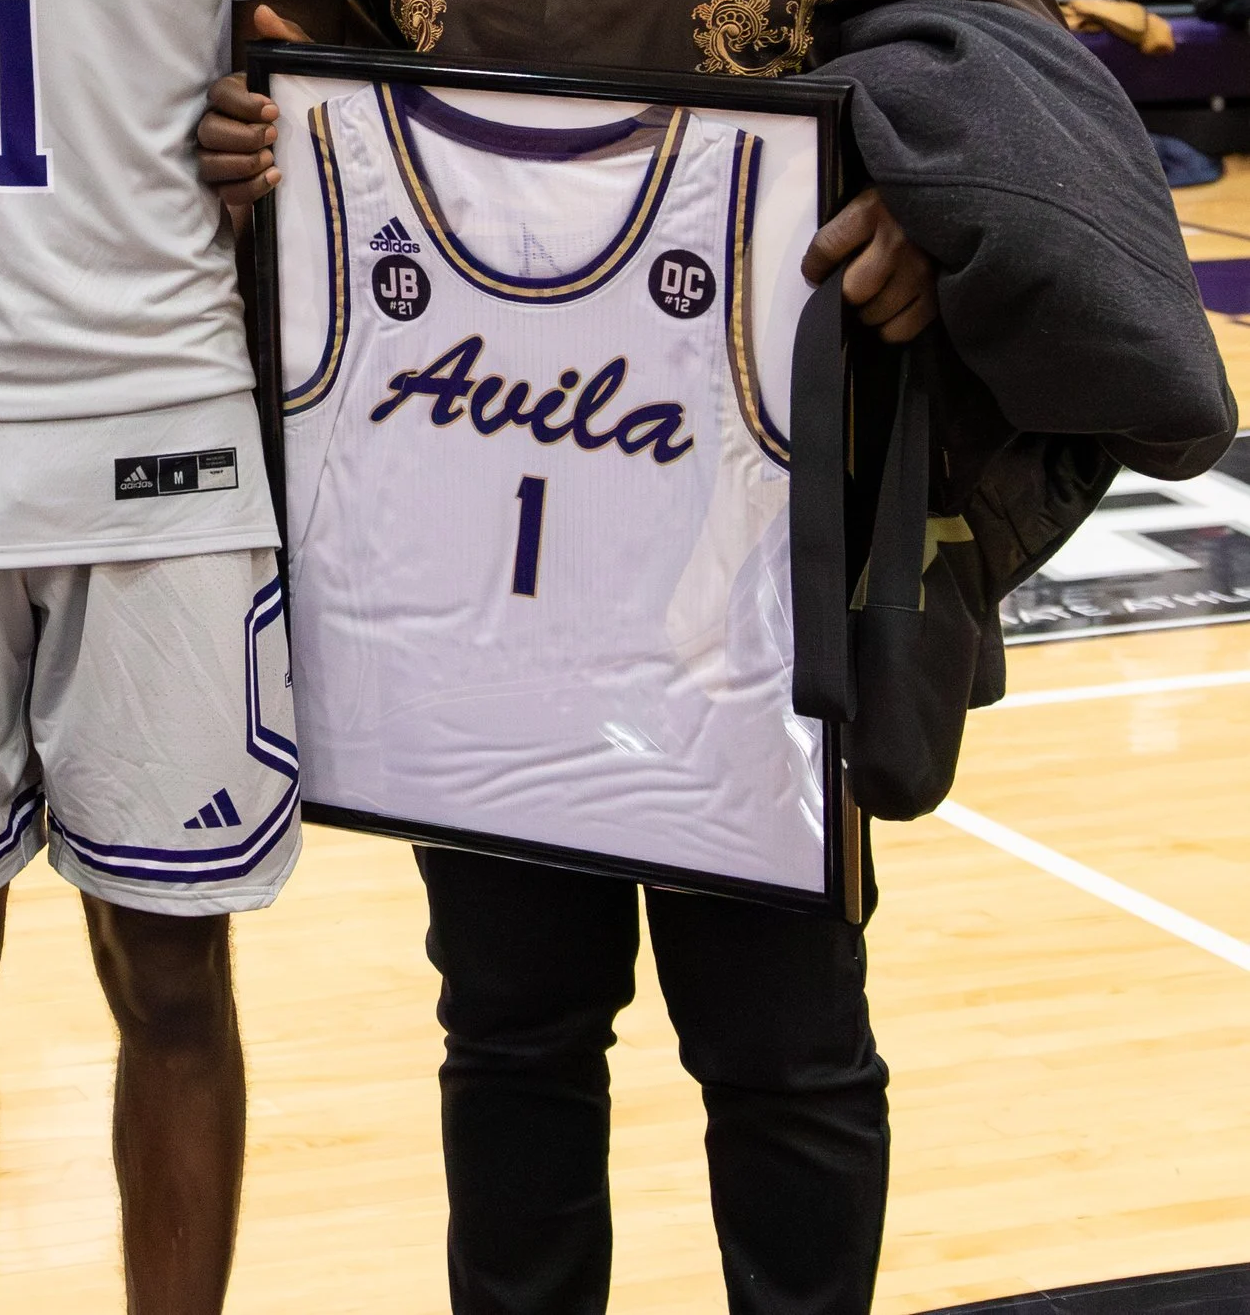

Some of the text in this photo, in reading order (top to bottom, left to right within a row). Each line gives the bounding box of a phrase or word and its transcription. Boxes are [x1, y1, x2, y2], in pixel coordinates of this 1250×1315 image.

[369, 239, 421, 254] adidas
[380, 267, 419, 299] JB
[660, 260, 706, 301] DC
[390, 301, 413, 316] #21
[664, 295, 691, 313] #12
[368, 333, 695, 467] Avila
[120, 479, 154, 491] adidas
[173, 470, 184, 485] M
[510, 474, 548, 599] 1
